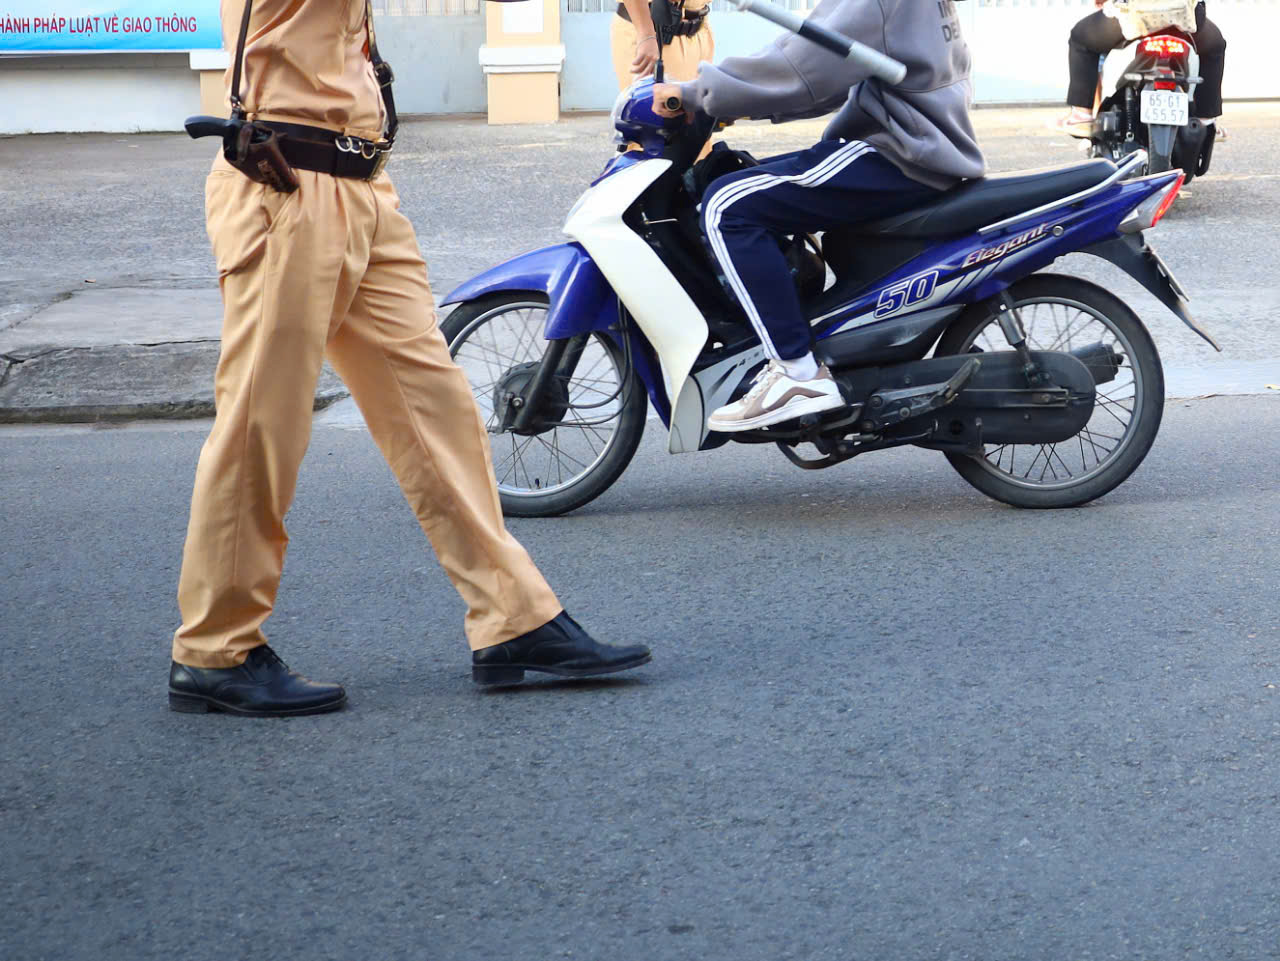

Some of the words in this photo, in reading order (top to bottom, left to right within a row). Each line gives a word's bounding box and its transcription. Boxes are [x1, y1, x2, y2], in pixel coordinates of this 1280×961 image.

[34, 13, 66, 33] PHÁP
[69, 14, 101, 37] LUẬT
[122, 16, 152, 33] GIAO
[155, 12, 197, 33] THÔNG
[961, 222, 1052, 270] Elegant
[873, 269, 940, 319] 50
